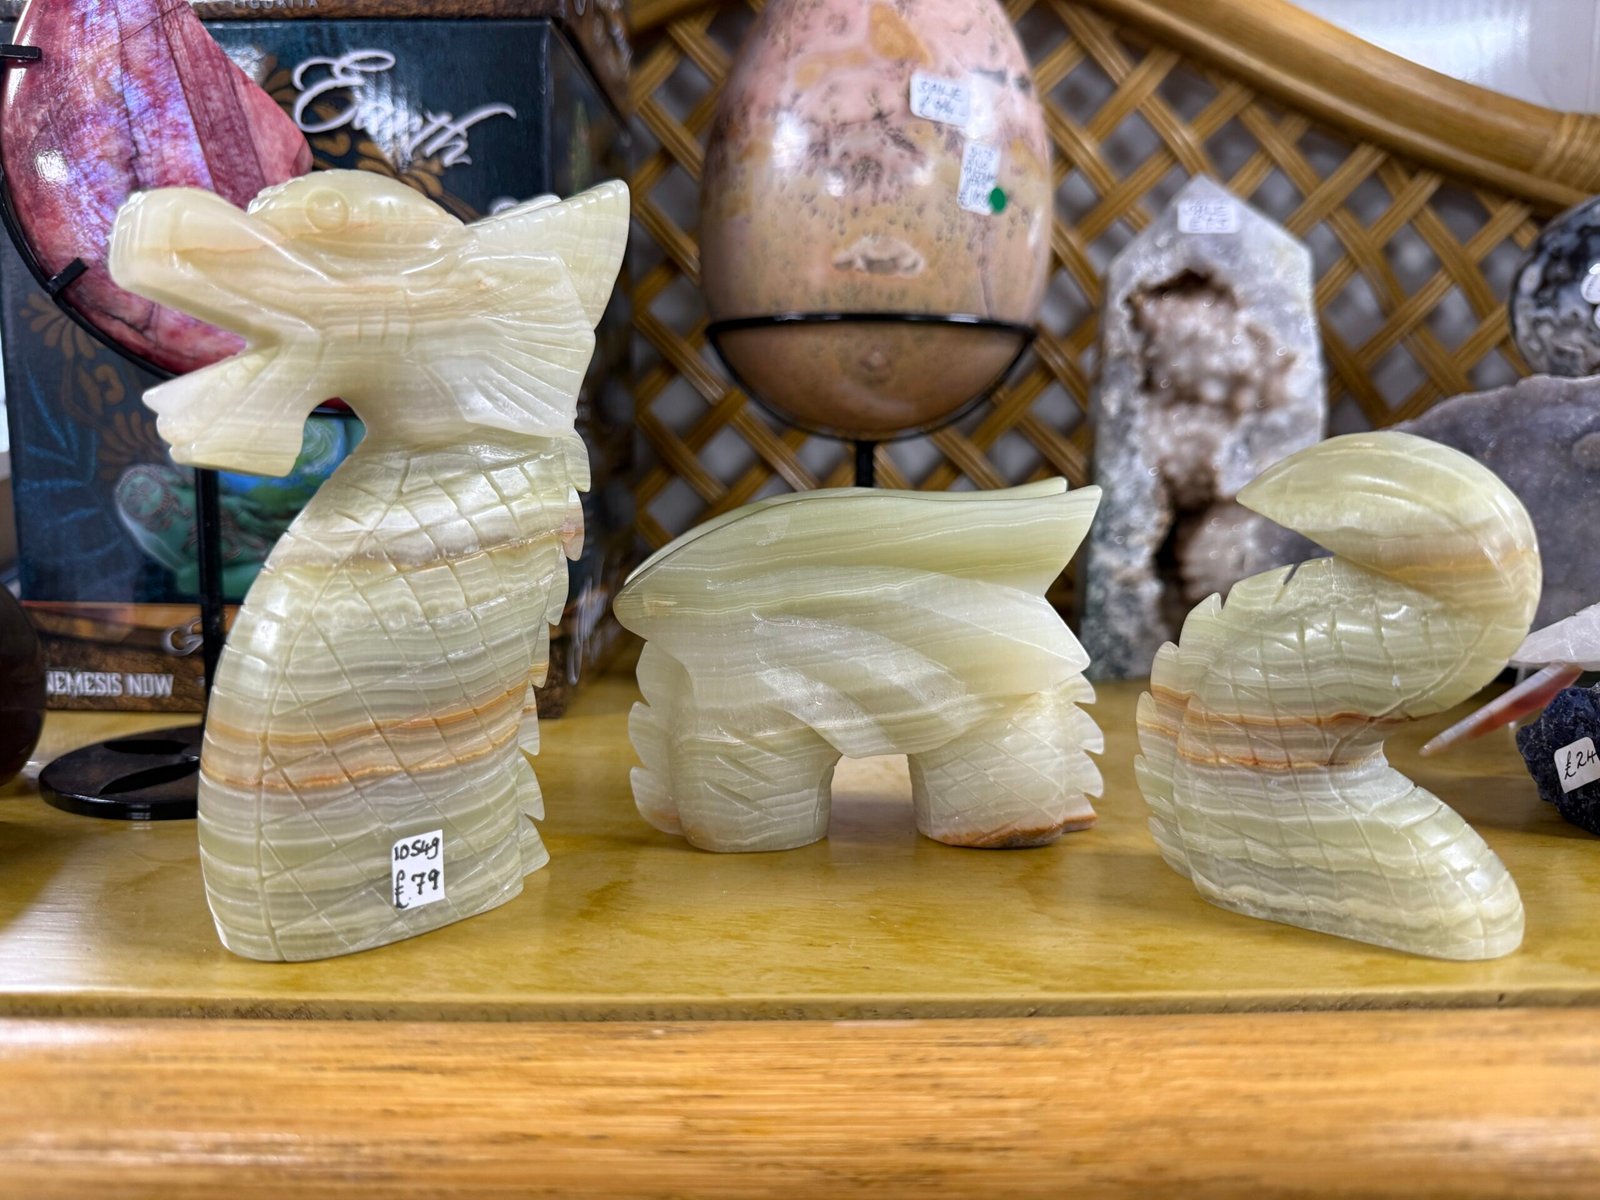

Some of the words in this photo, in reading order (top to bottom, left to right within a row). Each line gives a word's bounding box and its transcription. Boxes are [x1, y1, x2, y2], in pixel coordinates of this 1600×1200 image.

[46, 671, 122, 698] NEMESIS
[124, 673, 174, 698] NOW
[394, 836, 440, 861] 10549
